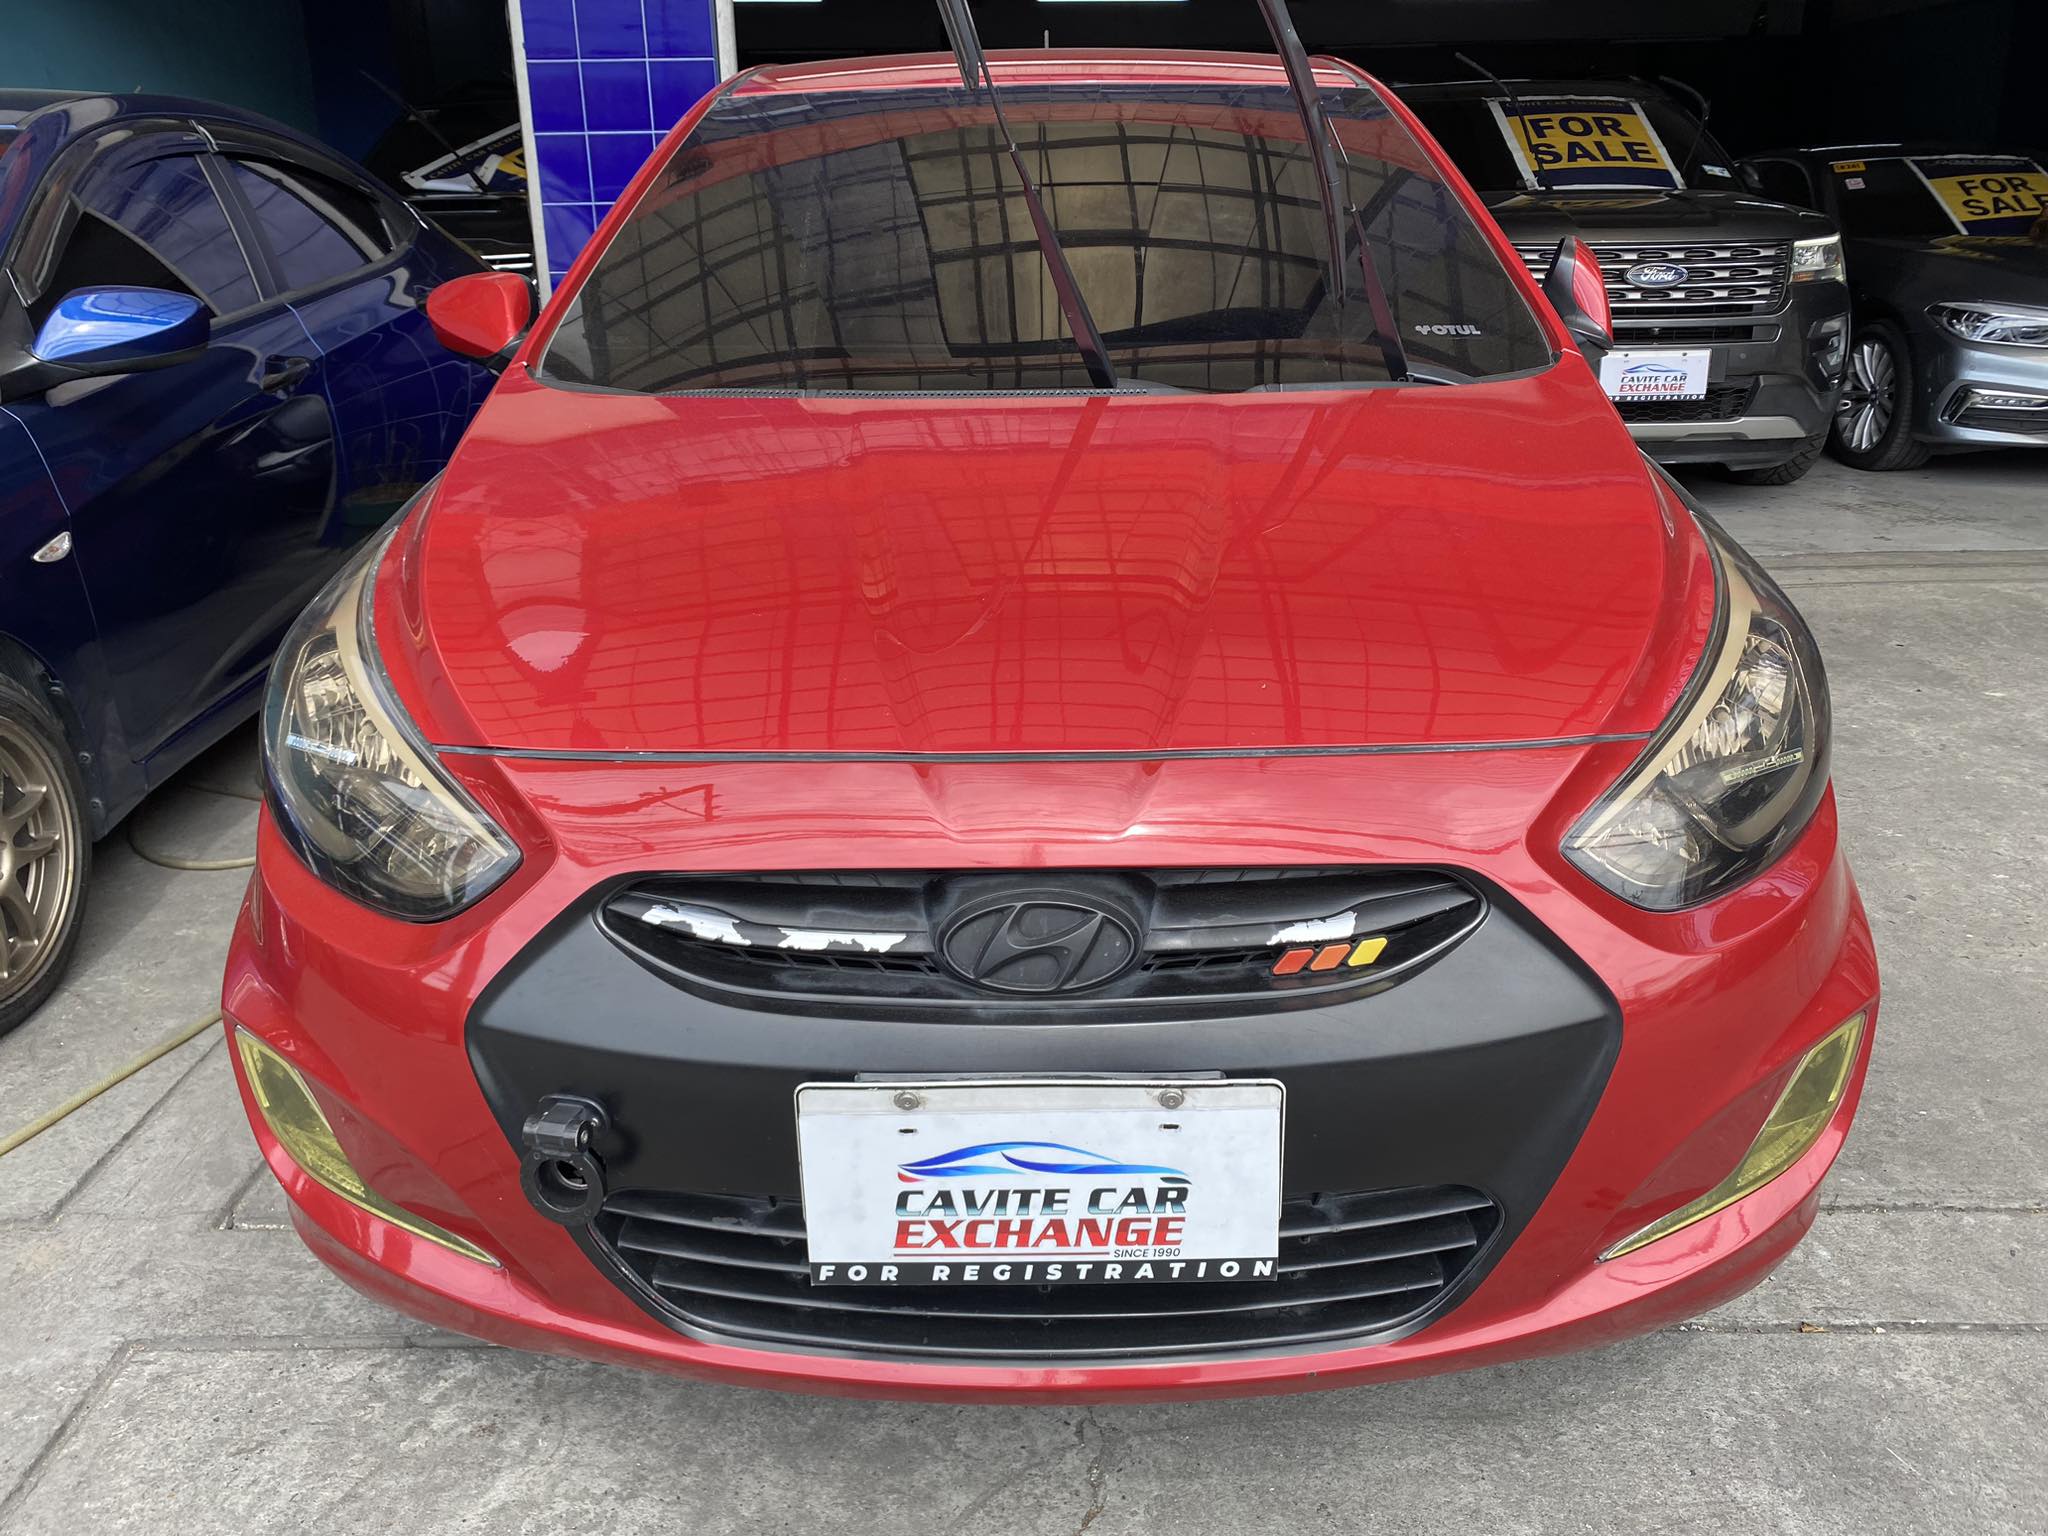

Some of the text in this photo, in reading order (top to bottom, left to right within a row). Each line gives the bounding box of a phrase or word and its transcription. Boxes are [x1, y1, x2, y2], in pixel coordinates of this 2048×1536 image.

[1528, 116, 1631, 138] FOR
[1533, 141, 1658, 164] SALE
[1957, 176, 2036, 197] FOR
[1640, 266, 1679, 281] Ford
[1619, 383, 1686, 393] EXCHANGE
[1621, 375, 1688, 384] CAVITE CAR
[895, 1186, 1189, 1217] CAVITE CAR
[893, 1217, 1186, 1248] EXCHANGE
[1113, 1247, 1181, 1258] SINCE 1990
[819, 1260, 1274, 1281] FOR REGISTRATION
